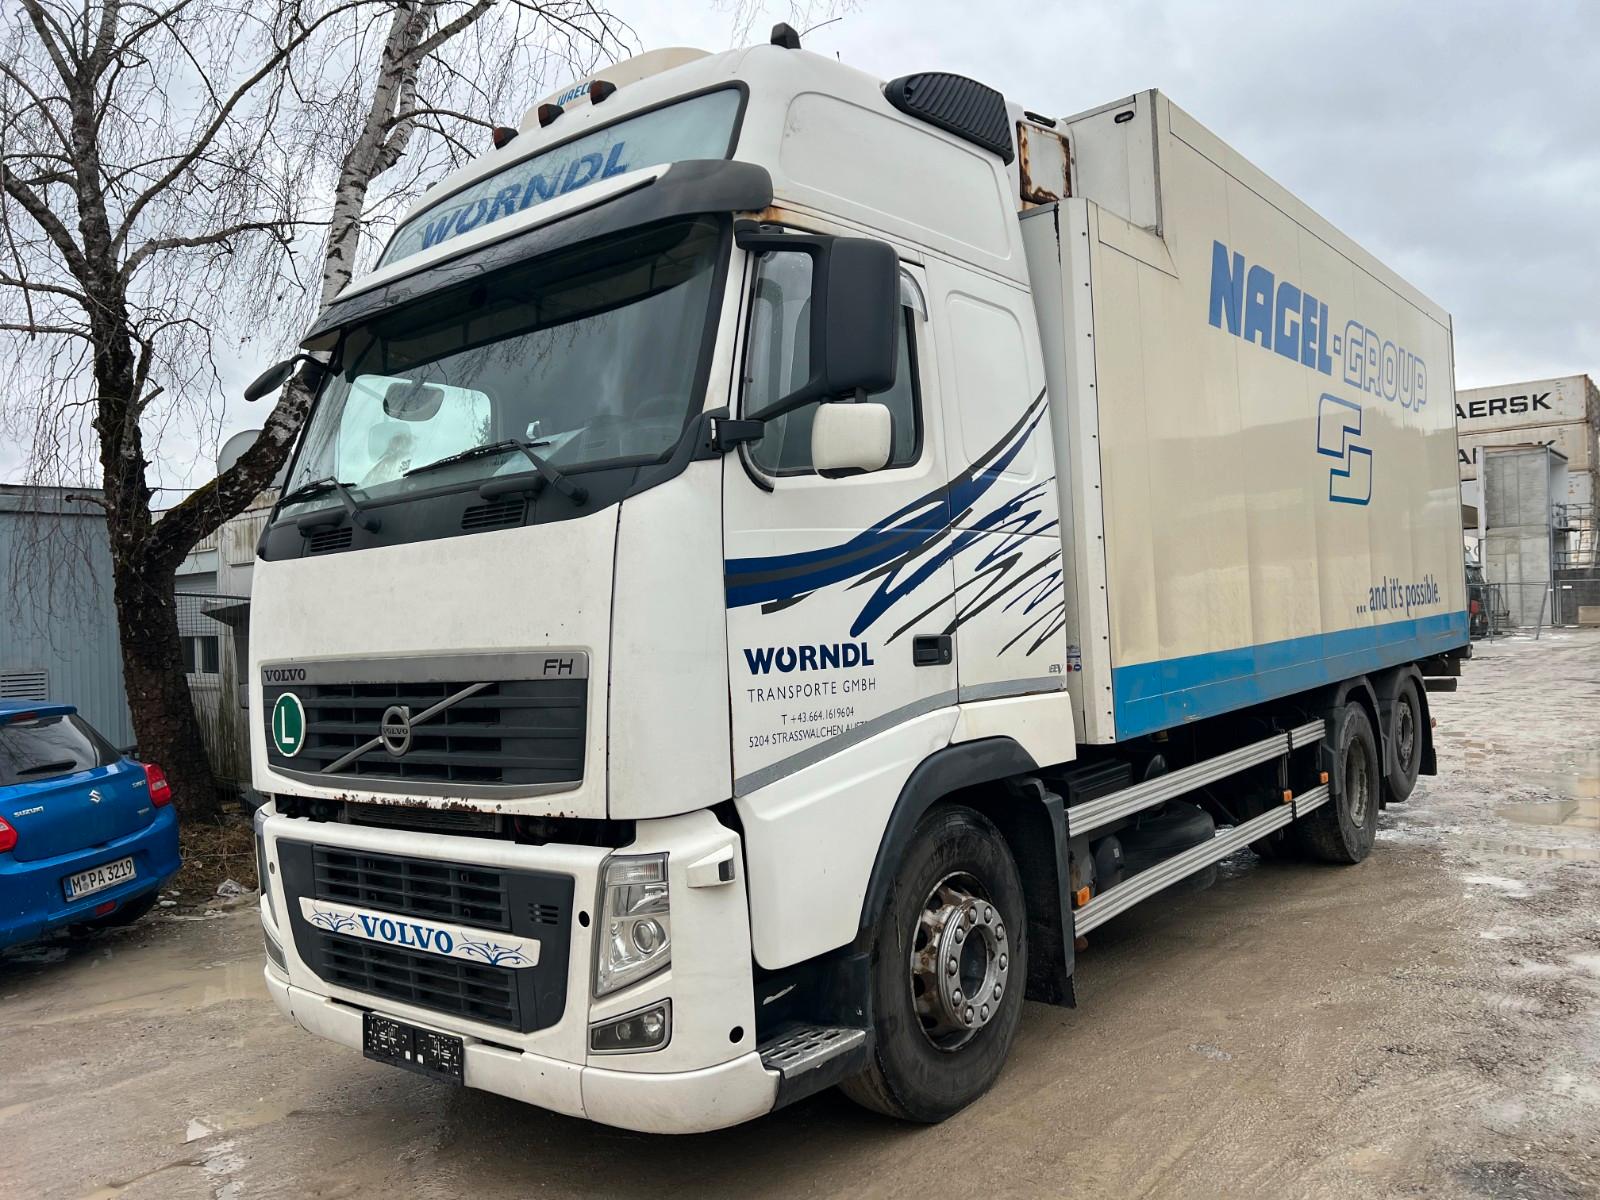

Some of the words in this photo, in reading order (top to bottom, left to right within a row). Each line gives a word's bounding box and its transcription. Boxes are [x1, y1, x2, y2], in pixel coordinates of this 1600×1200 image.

[1209, 239, 1428, 412] NAGEL-GROUP
[1456, 391, 1552, 420] AERSK
[1369, 576, 1387, 611] and
[1390, 578, 1403, 608] it's
[1406, 573, 1440, 616] possible.
[263, 668, 306, 682] VOLVO
[543, 658, 573, 675] FH
[747, 681, 837, 702] TRANSPORTE
[843, 677, 876, 693] GMBH
[281, 706, 295, 744] L
[383, 727, 409, 735] VOLVO
[781, 714, 788, 725] T
[749, 735, 769, 748] 5204
[772, 725, 844, 745] STRASSWALCHEN
[72, 877, 82, 894] M
[88, 870, 106, 888] PA
[106, 860, 132, 881] 3219
[358, 915, 454, 954] VOLVO
